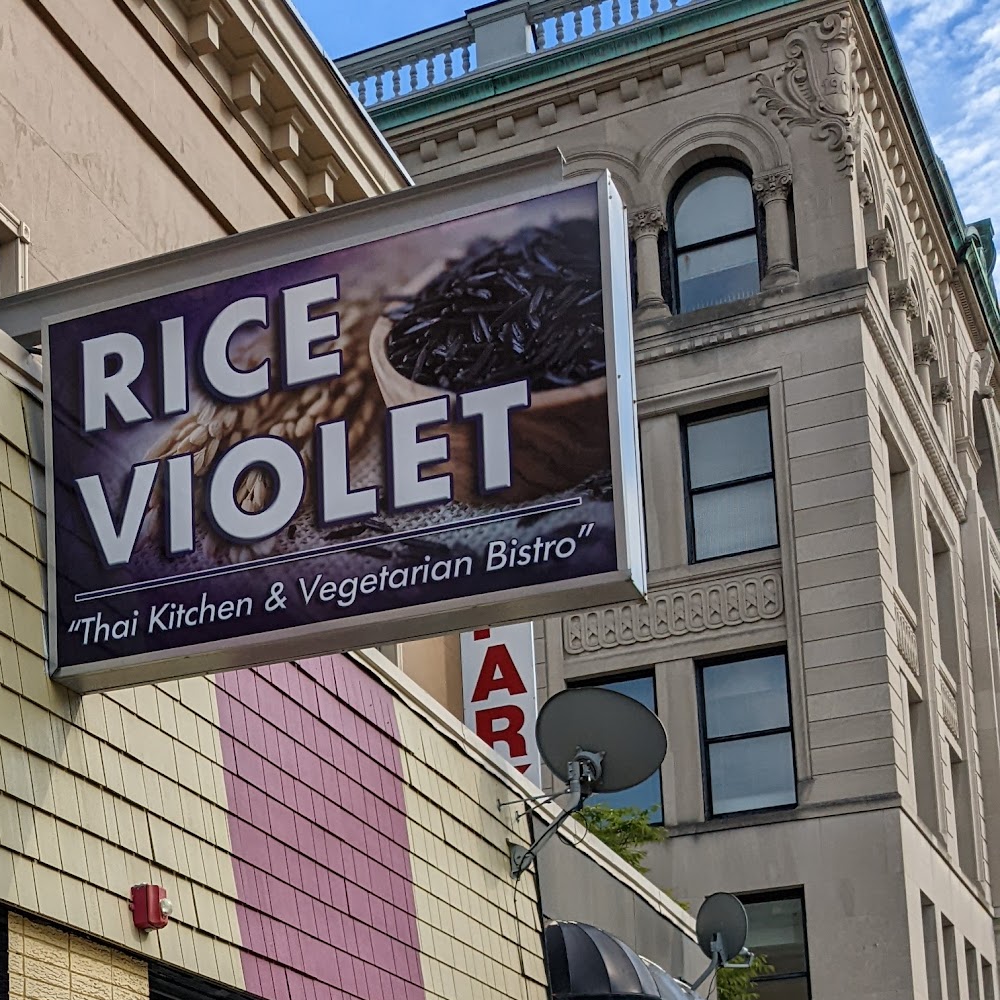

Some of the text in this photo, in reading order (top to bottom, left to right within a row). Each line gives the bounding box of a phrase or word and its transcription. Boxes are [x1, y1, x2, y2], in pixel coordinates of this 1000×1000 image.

[81, 275, 342, 433] RICE
[75, 379, 530, 567] VIOLET
[148, 592, 253, 633] Kitchen
[264, 581, 288, 612] &
[299, 555, 472, 607] Vegetarian
